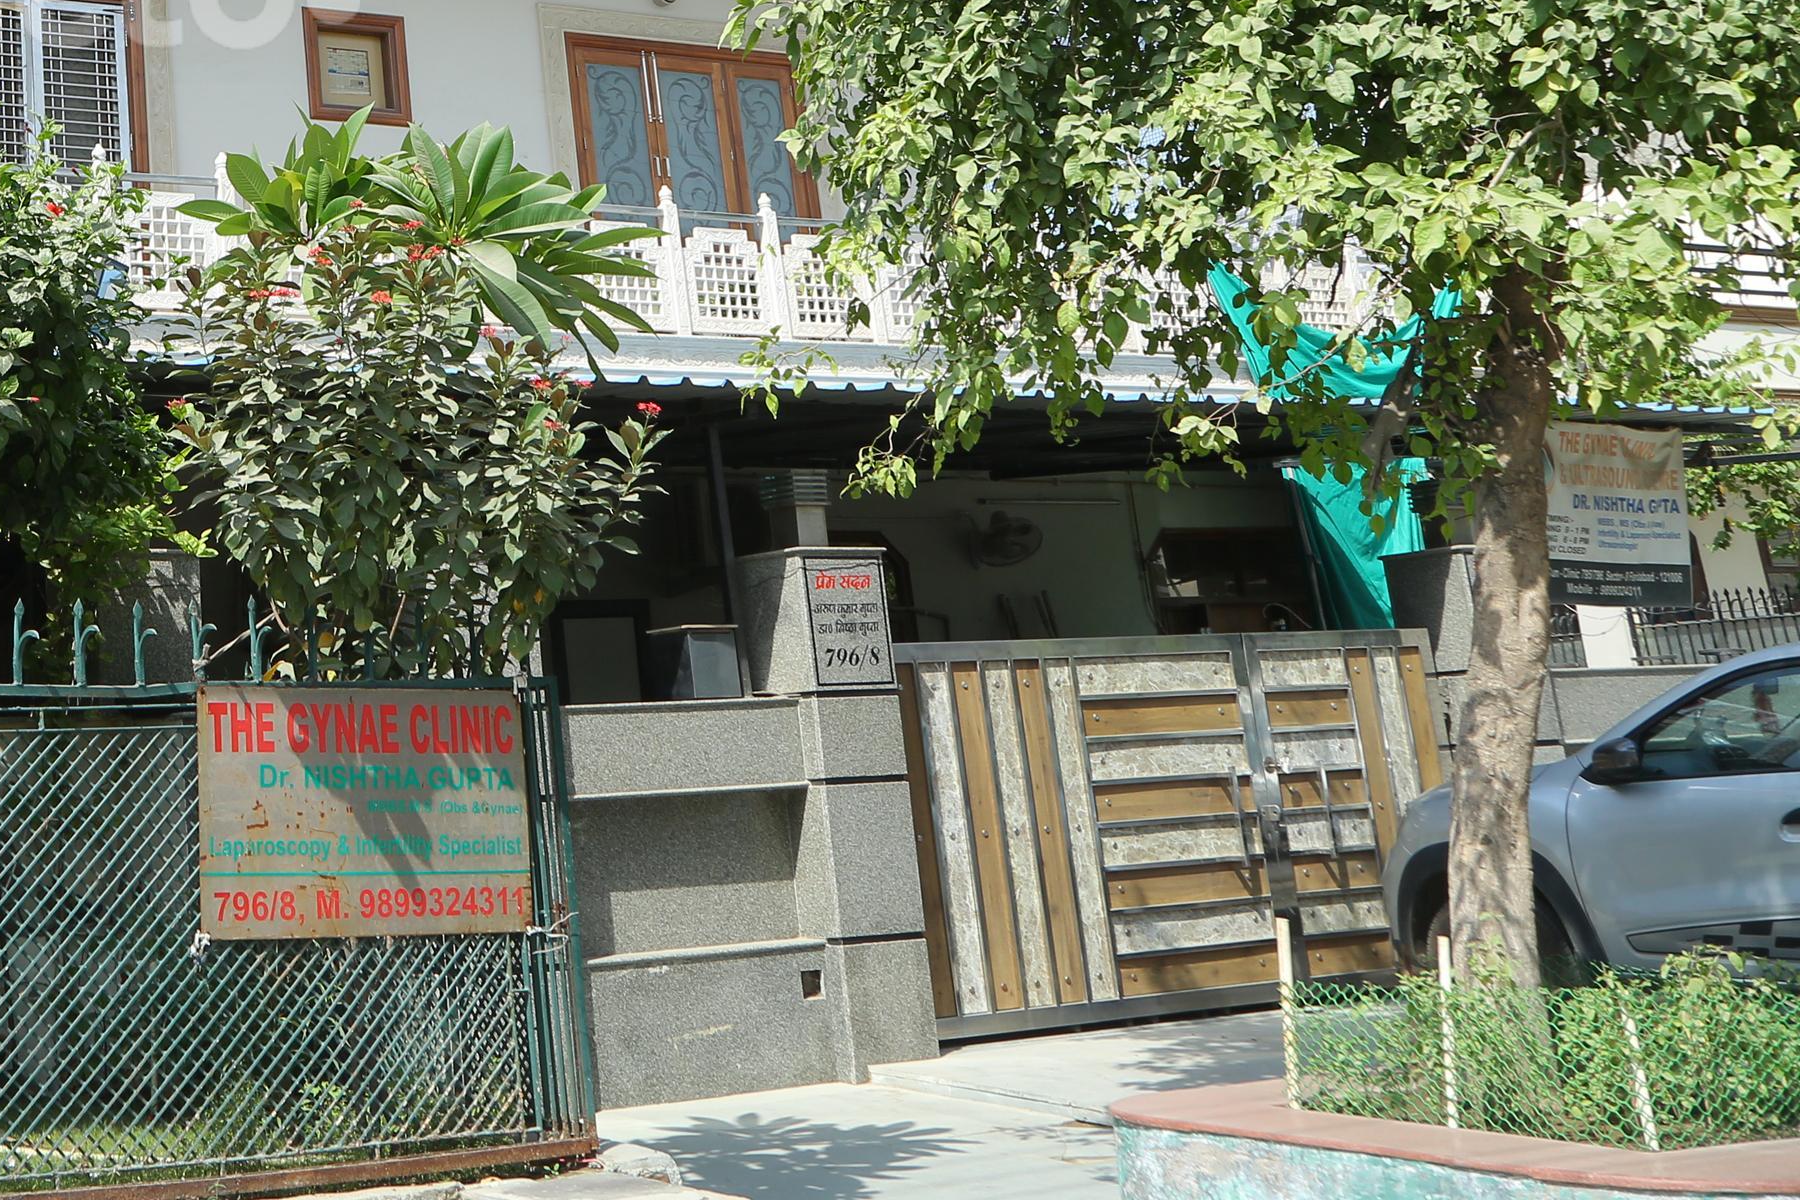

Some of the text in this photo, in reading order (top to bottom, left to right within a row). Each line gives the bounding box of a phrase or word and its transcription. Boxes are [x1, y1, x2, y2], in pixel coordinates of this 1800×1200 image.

[1559, 431, 1579, 454] THE
[1573, 493, 1591, 510] DR.
[1593, 495, 1645, 513] NISHTHA
[1558, 545, 1587, 555] CLOSED
[815, 570, 871, 590] प्रेम सदन
[1566, 582, 1593, 595] Mobile
[825, 644, 881, 671] 796/8
[207, 701, 514, 755] THE GYNAE CLINIC
[258, 763, 516, 791] Dr. NISHTHA GUPTA
[439, 799, 468, 815] (Obs
[209, 834, 522, 861] Laparoscopy & Infertility Specialist
[213, 887, 525, 926] 796/8, M. 9899324311
